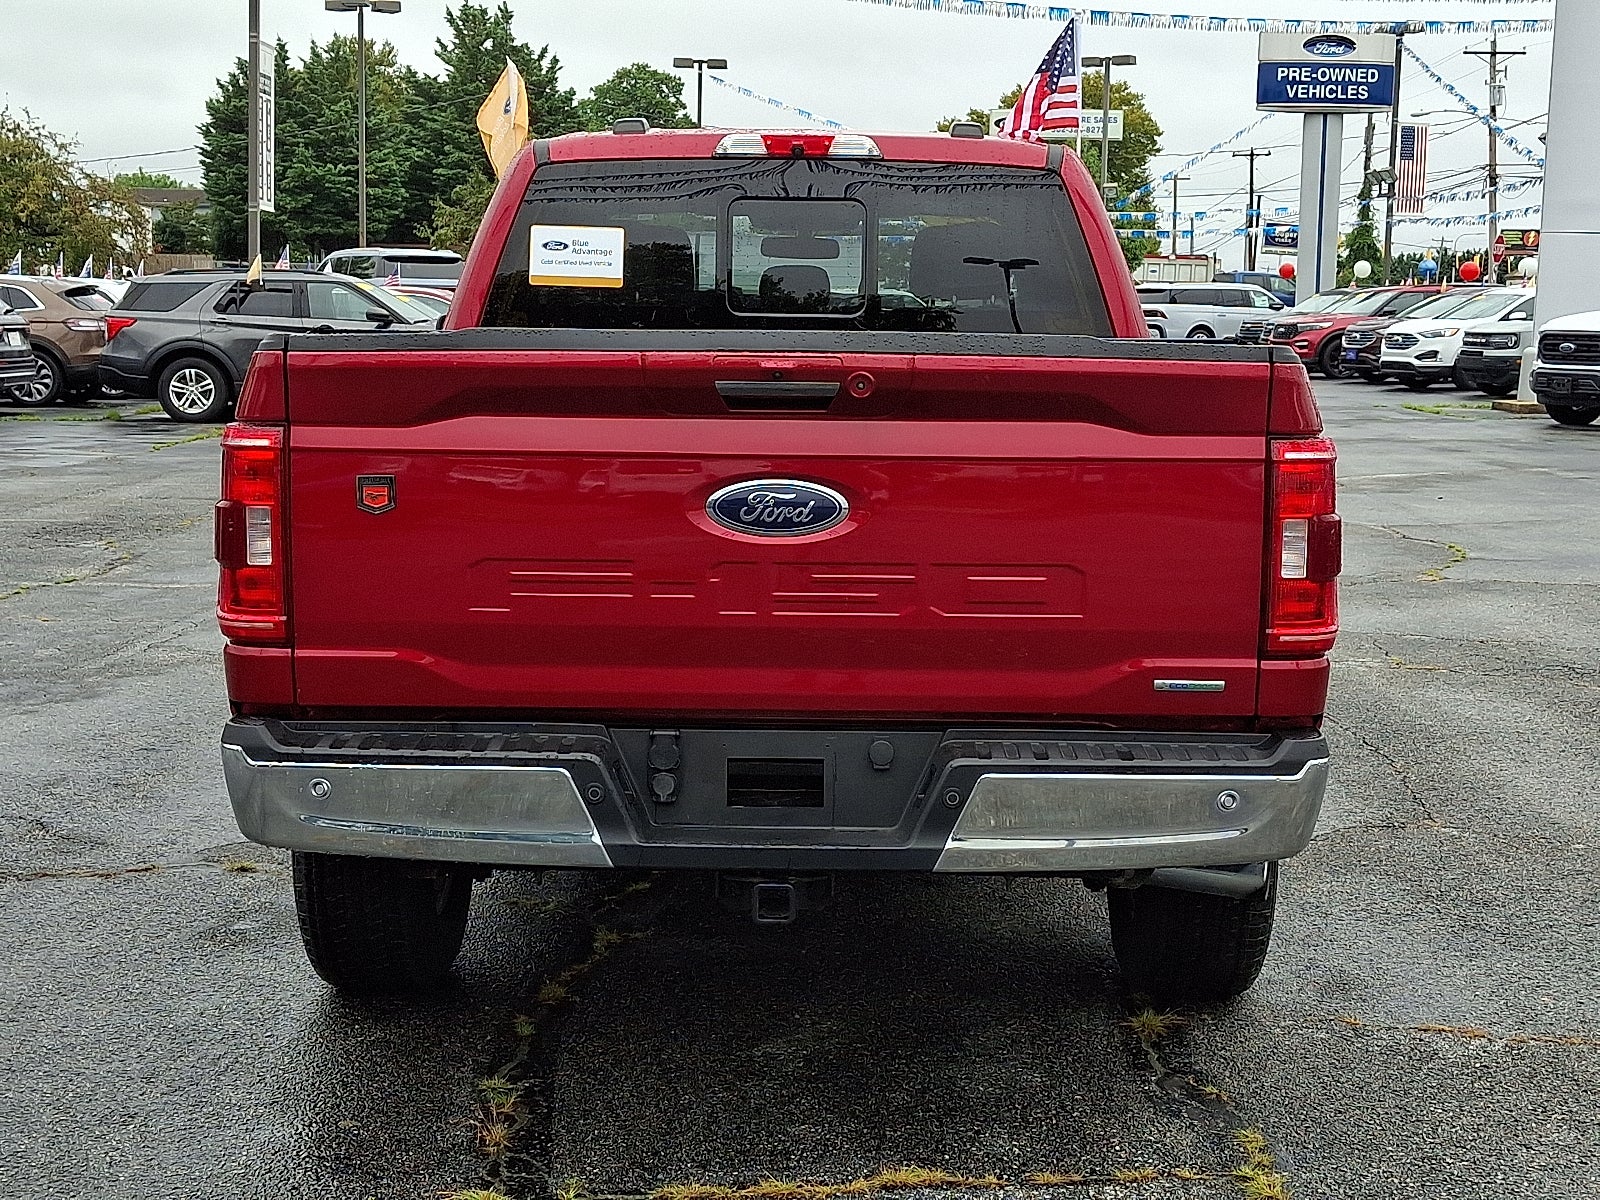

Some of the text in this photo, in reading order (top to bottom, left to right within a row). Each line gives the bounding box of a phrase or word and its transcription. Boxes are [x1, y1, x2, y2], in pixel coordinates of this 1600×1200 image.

[1277, 67, 1379, 83] PRE-OWNED
[1286, 84, 1369, 99] VEHICLES
[571, 239, 589, 247] Blue
[571, 247, 613, 256] Advantage
[739, 491, 816, 523] Ford
